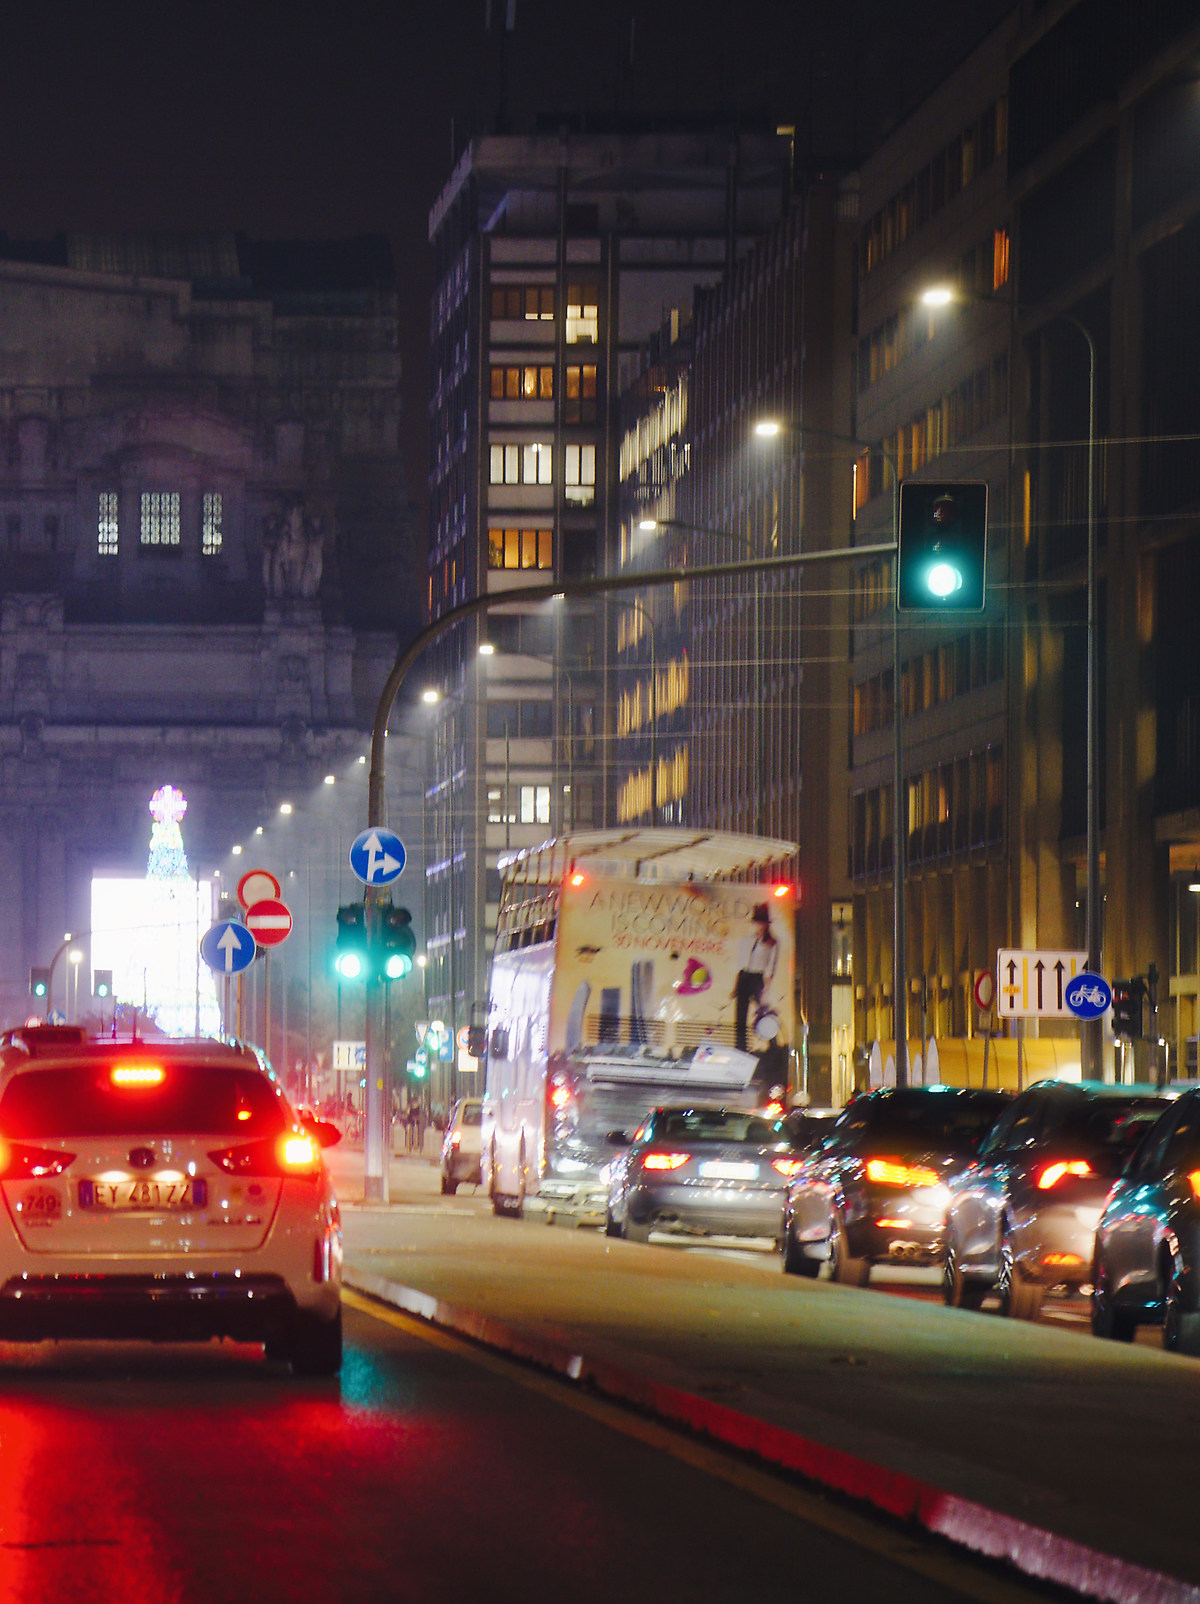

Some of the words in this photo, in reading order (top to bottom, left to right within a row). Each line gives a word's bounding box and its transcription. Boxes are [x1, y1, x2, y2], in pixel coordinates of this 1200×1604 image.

[588, 891, 604, 911] A
[609, 889, 664, 914] NEW
[666, 892, 749, 920] WORLD
[611, 912, 629, 934] IS
[632, 912, 728, 938] COMING
[634, 936, 725, 955] NOVEMBRE
[95, 1184, 118, 1205] EY
